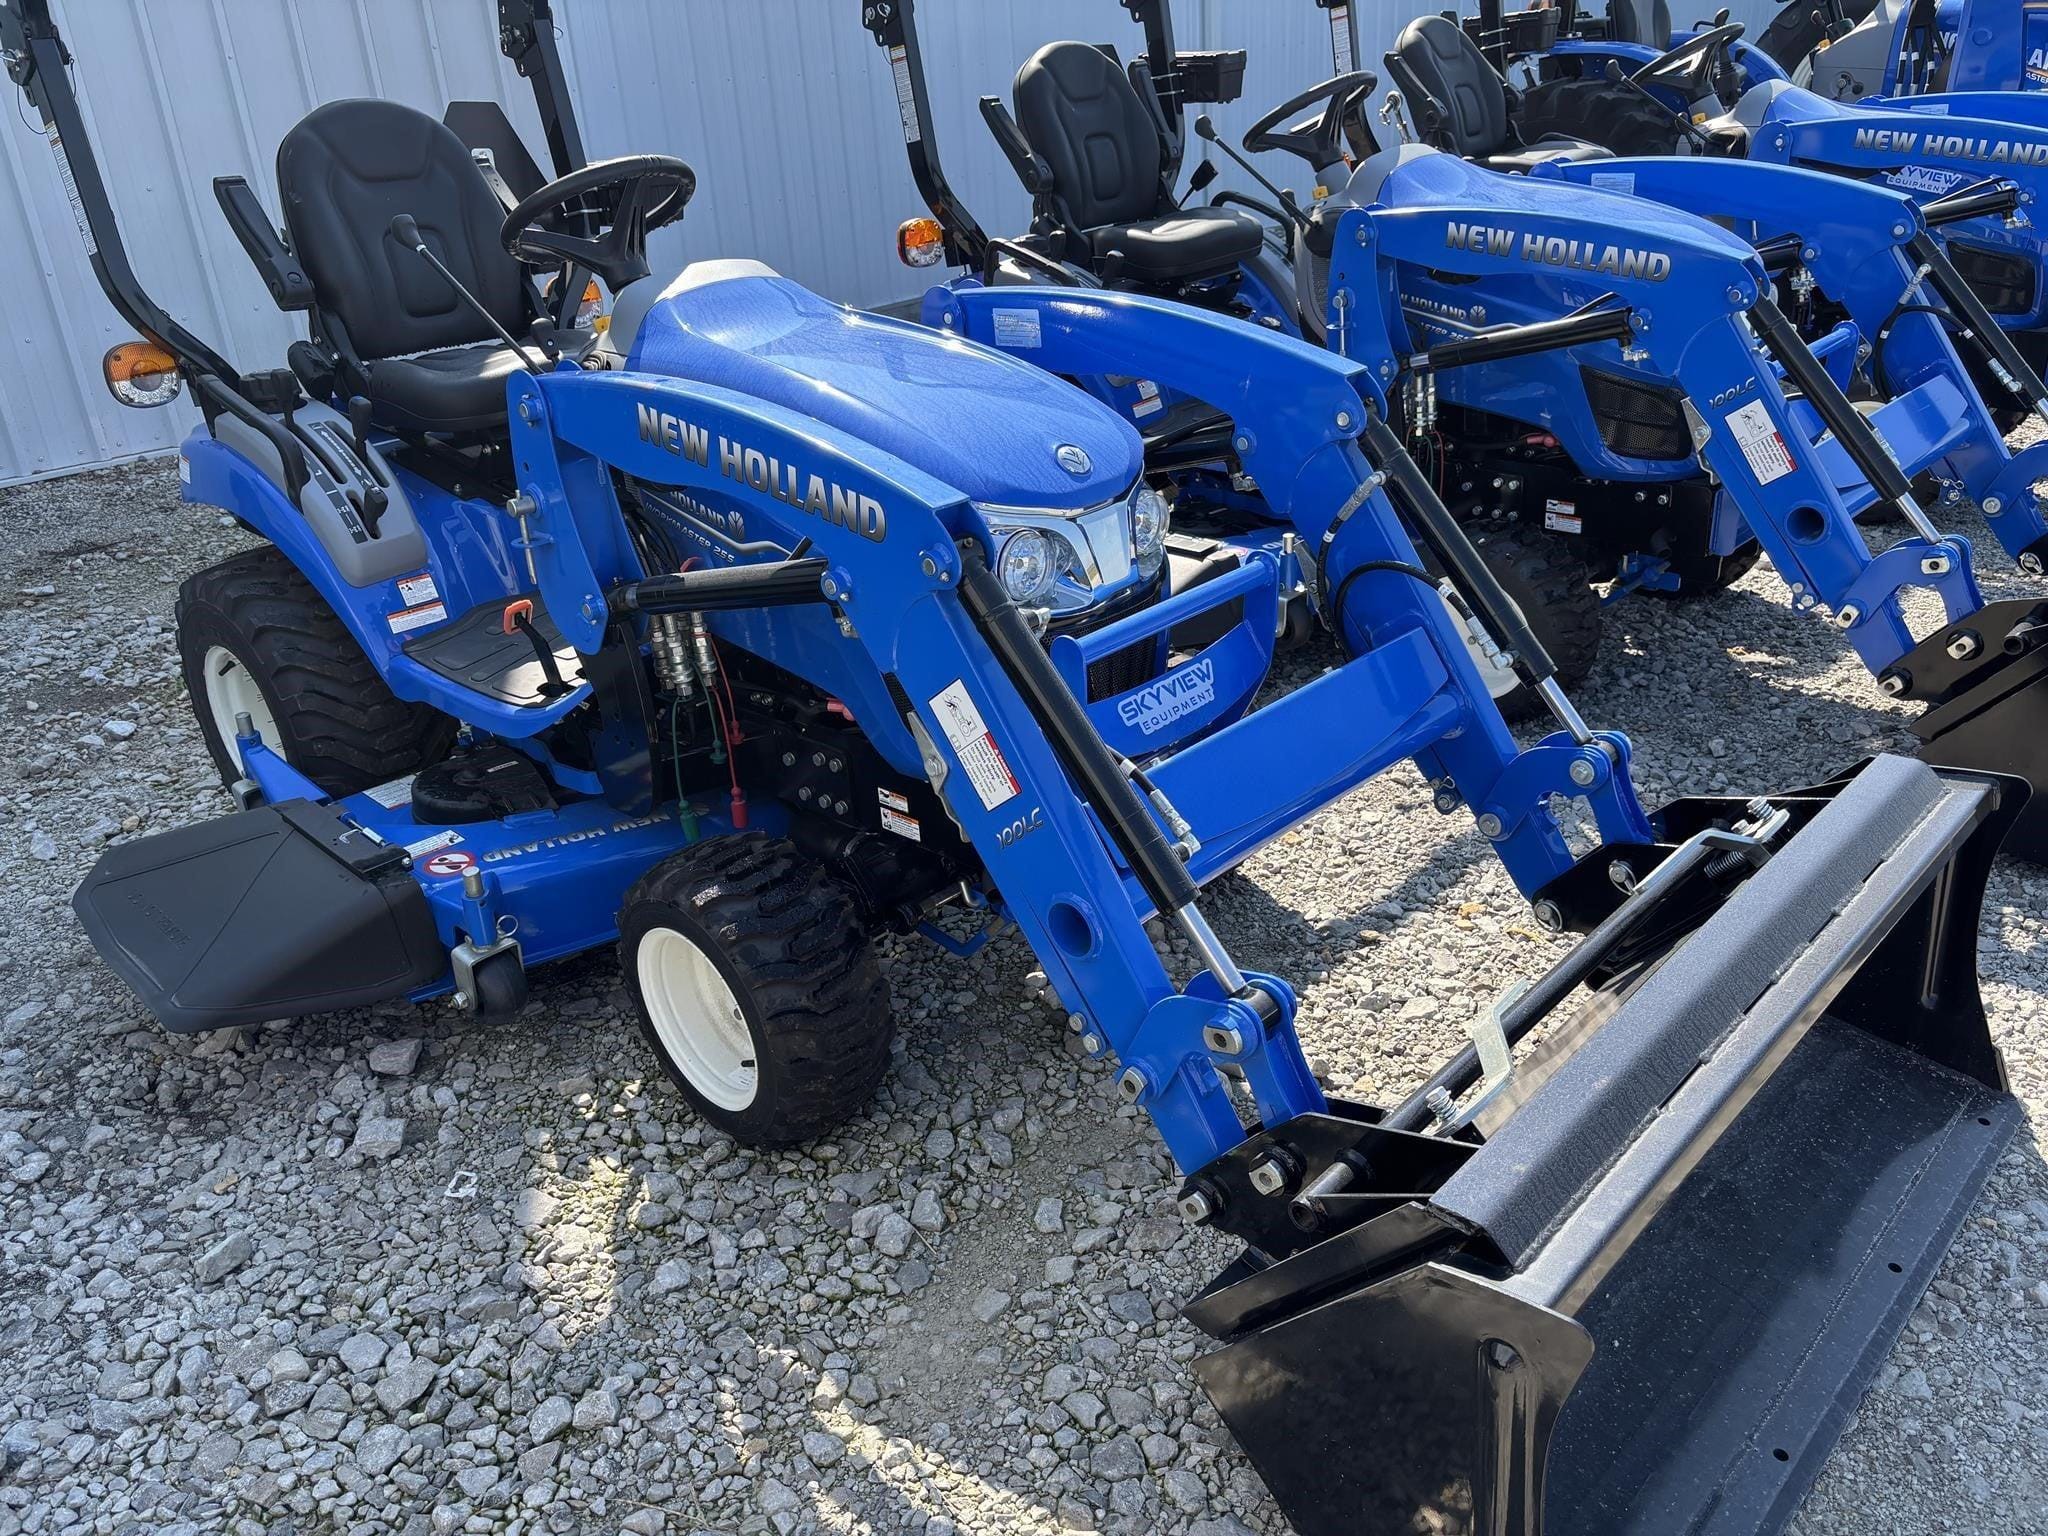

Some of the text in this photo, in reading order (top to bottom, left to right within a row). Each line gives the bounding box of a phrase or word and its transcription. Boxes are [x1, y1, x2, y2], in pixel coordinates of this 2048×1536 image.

[1855, 127, 2048, 167] NEW HOLLAND
[1888, 176, 1947, 192] EQUIPMENT
[1905, 166, 1961, 186] YVIEW
[1446, 221, 1671, 282] NEW HOLLAND
[637, 402, 887, 544] NEW HOLLAND
[1120, 662, 1213, 722] SKYVIEW
[1142, 688, 1213, 731] EQUIPMENT
